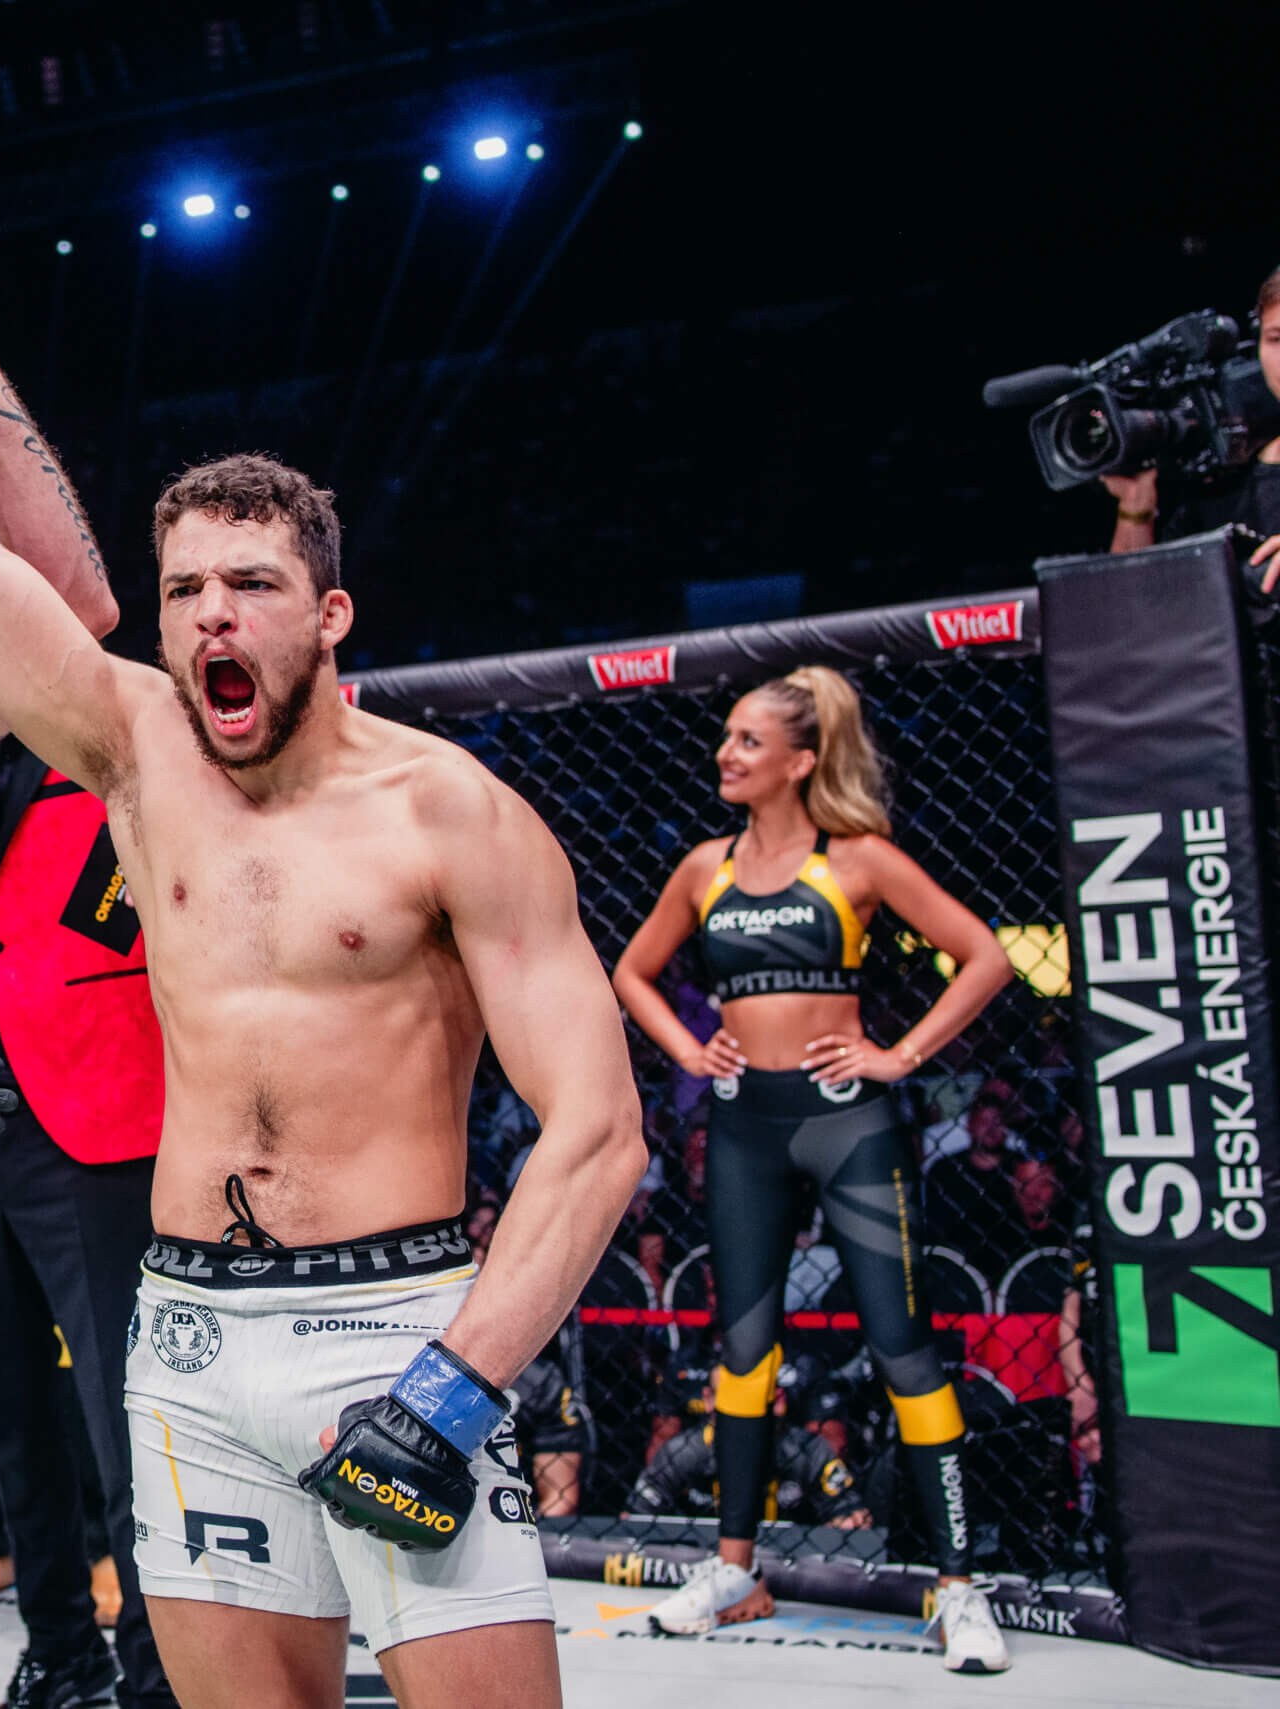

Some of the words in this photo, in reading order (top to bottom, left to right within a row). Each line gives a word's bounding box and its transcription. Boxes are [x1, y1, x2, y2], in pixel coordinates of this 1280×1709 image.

[707, 905, 815, 932] OKTAGON
[1181, 806, 1248, 1041] ENERGIE
[730, 969, 847, 995] PITBULL
[1071, 812, 1204, 1240] SEV.EN
[1195, 1052, 1268, 1241] ČESKÁ
[143, 1240, 214, 1278] ULL
[172, 1312, 196, 1326] DCA
[167, 1357, 203, 1370] IRELAND
[337, 1458, 456, 1533] OKTAGON
[391, 1476, 419, 1500] MMA
[939, 1454, 968, 1551] OKTAGON
